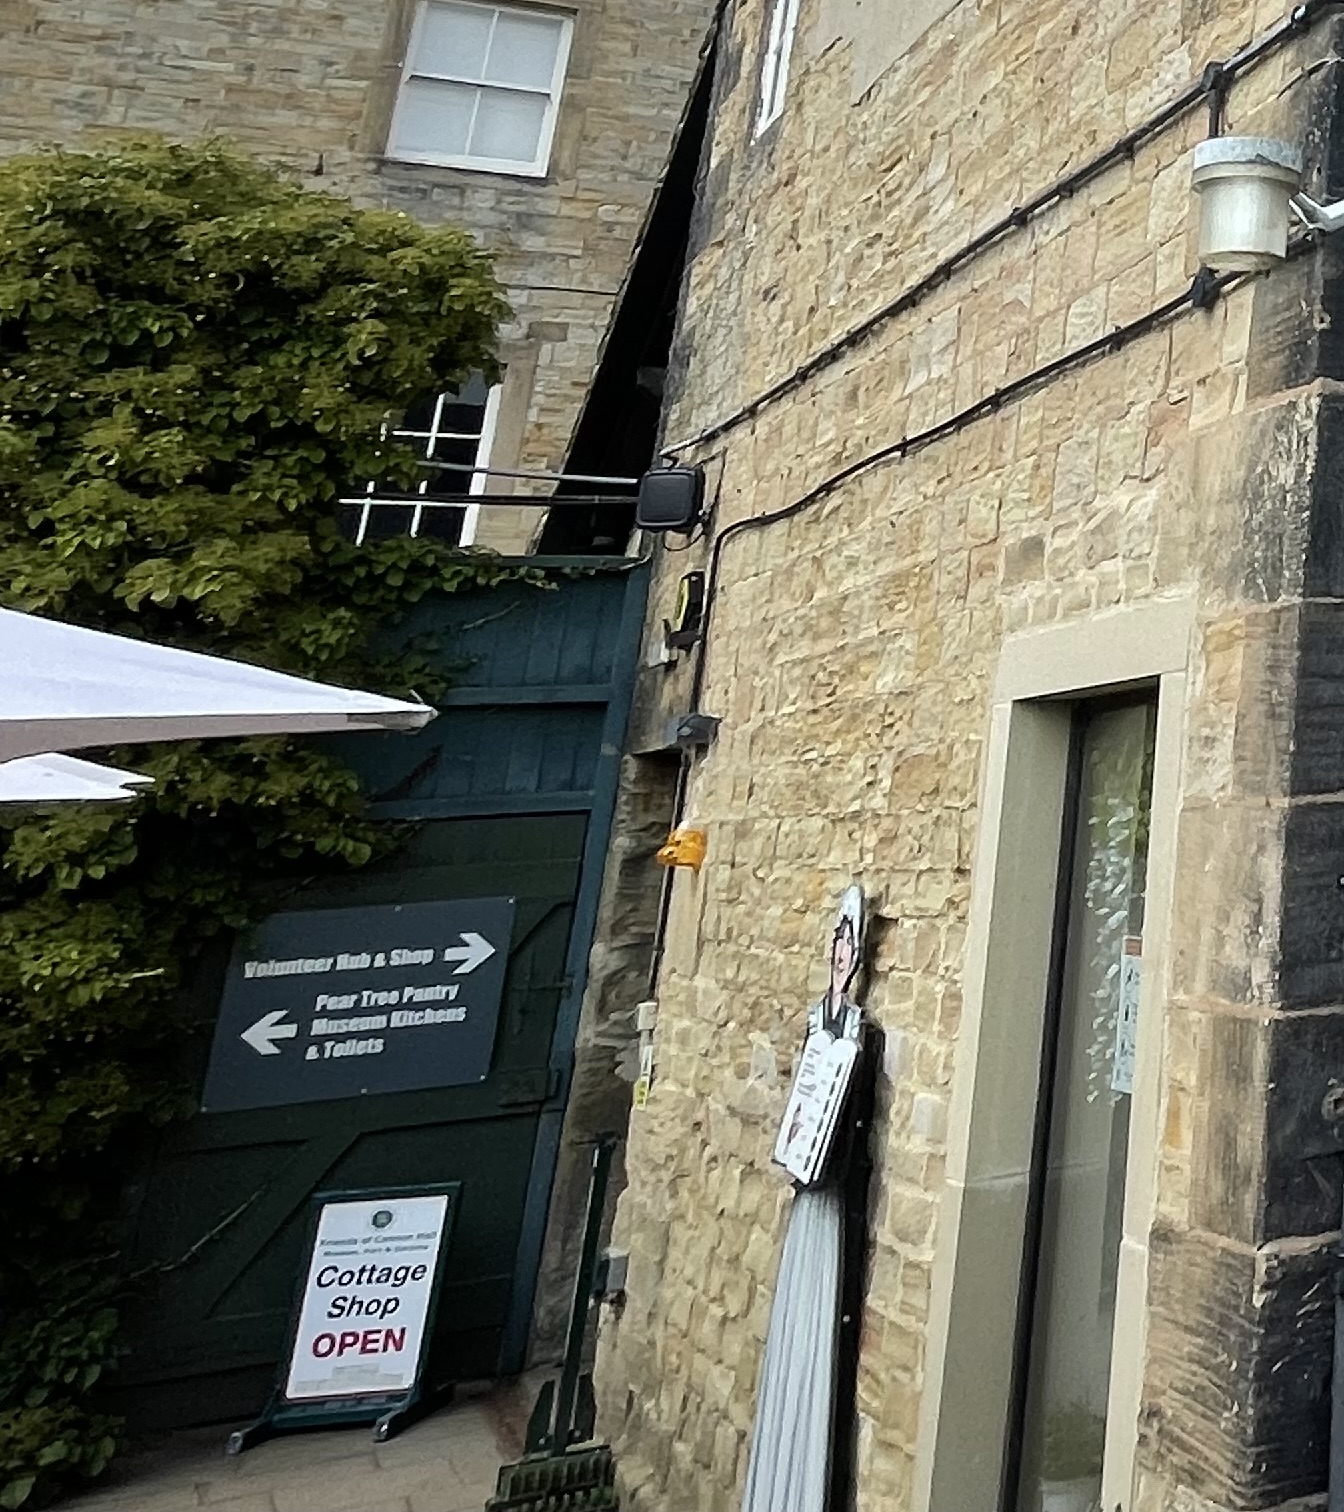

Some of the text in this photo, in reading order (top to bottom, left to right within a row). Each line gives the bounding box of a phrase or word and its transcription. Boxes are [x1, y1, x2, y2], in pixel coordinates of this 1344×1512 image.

[244, 948, 434, 979] Volunteer Hub & Shop
[315, 984, 460, 1012] Pear Tree Pantry
[310, 1006, 467, 1036] Museum Kitchens
[305, 1038, 384, 1060] & Toilets
[316, 1263, 428, 1288] Cottage
[326, 1295, 400, 1319] Shop
[312, 1327, 407, 1358] OPEN
